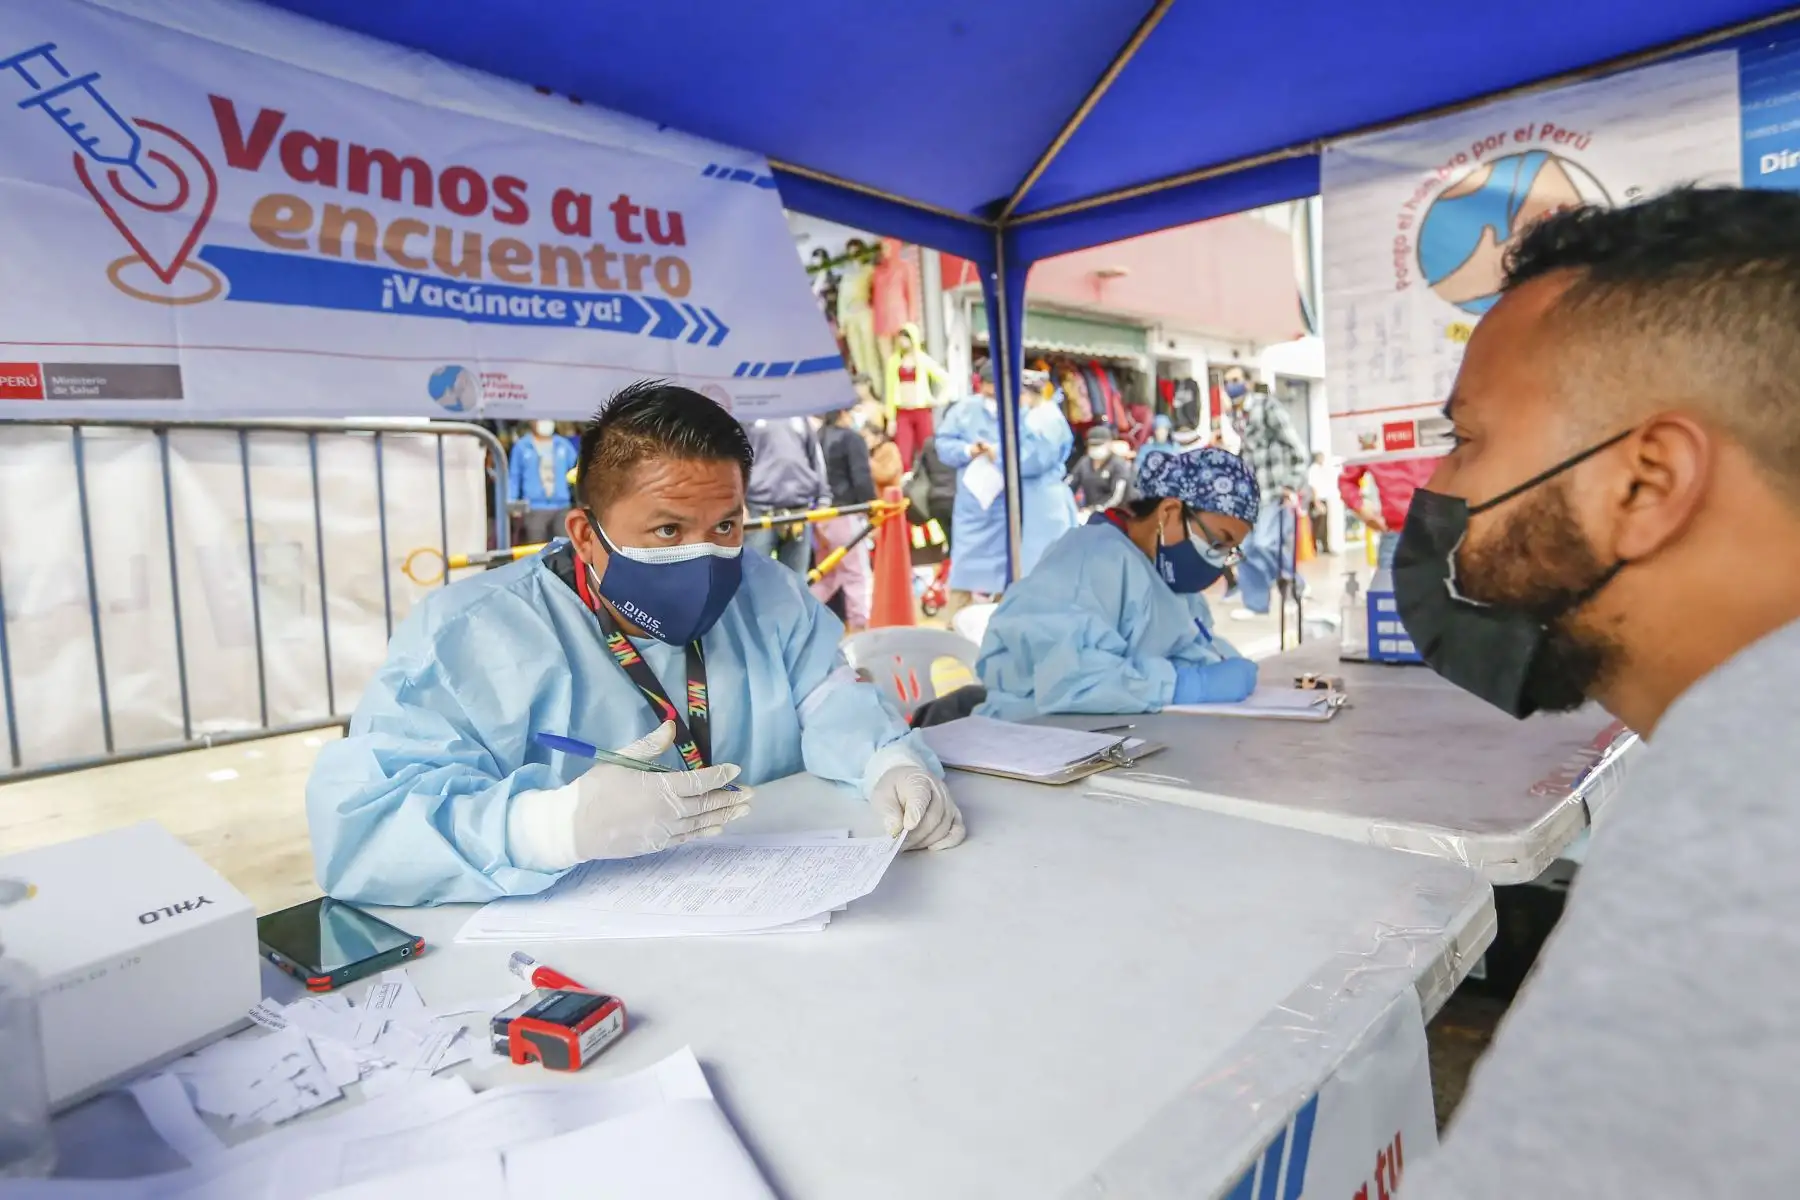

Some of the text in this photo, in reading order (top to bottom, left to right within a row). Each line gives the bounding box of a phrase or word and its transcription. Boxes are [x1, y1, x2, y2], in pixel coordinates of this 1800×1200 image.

[1471, 131, 1507, 158] por
[1513, 122, 1534, 142] el
[1539, 122, 1594, 151] Perú
[208, 93, 686, 246] Vamos a tu
[249, 193, 692, 298] encuentro
[382, 274, 622, 326] ¡Vacúnate ya!
[0, 374, 37, 387] PERÚ
[52, 376, 107, 386] Ministerio
[70, 386, 99, 395] Salud
[612, 600, 666, 638] Lima Centro
[624, 601, 661, 629] DIRIS
[607, 632, 641, 666] NIKE
[688, 680, 707, 720] NIKE
[138, 896, 214, 925] YHLO
